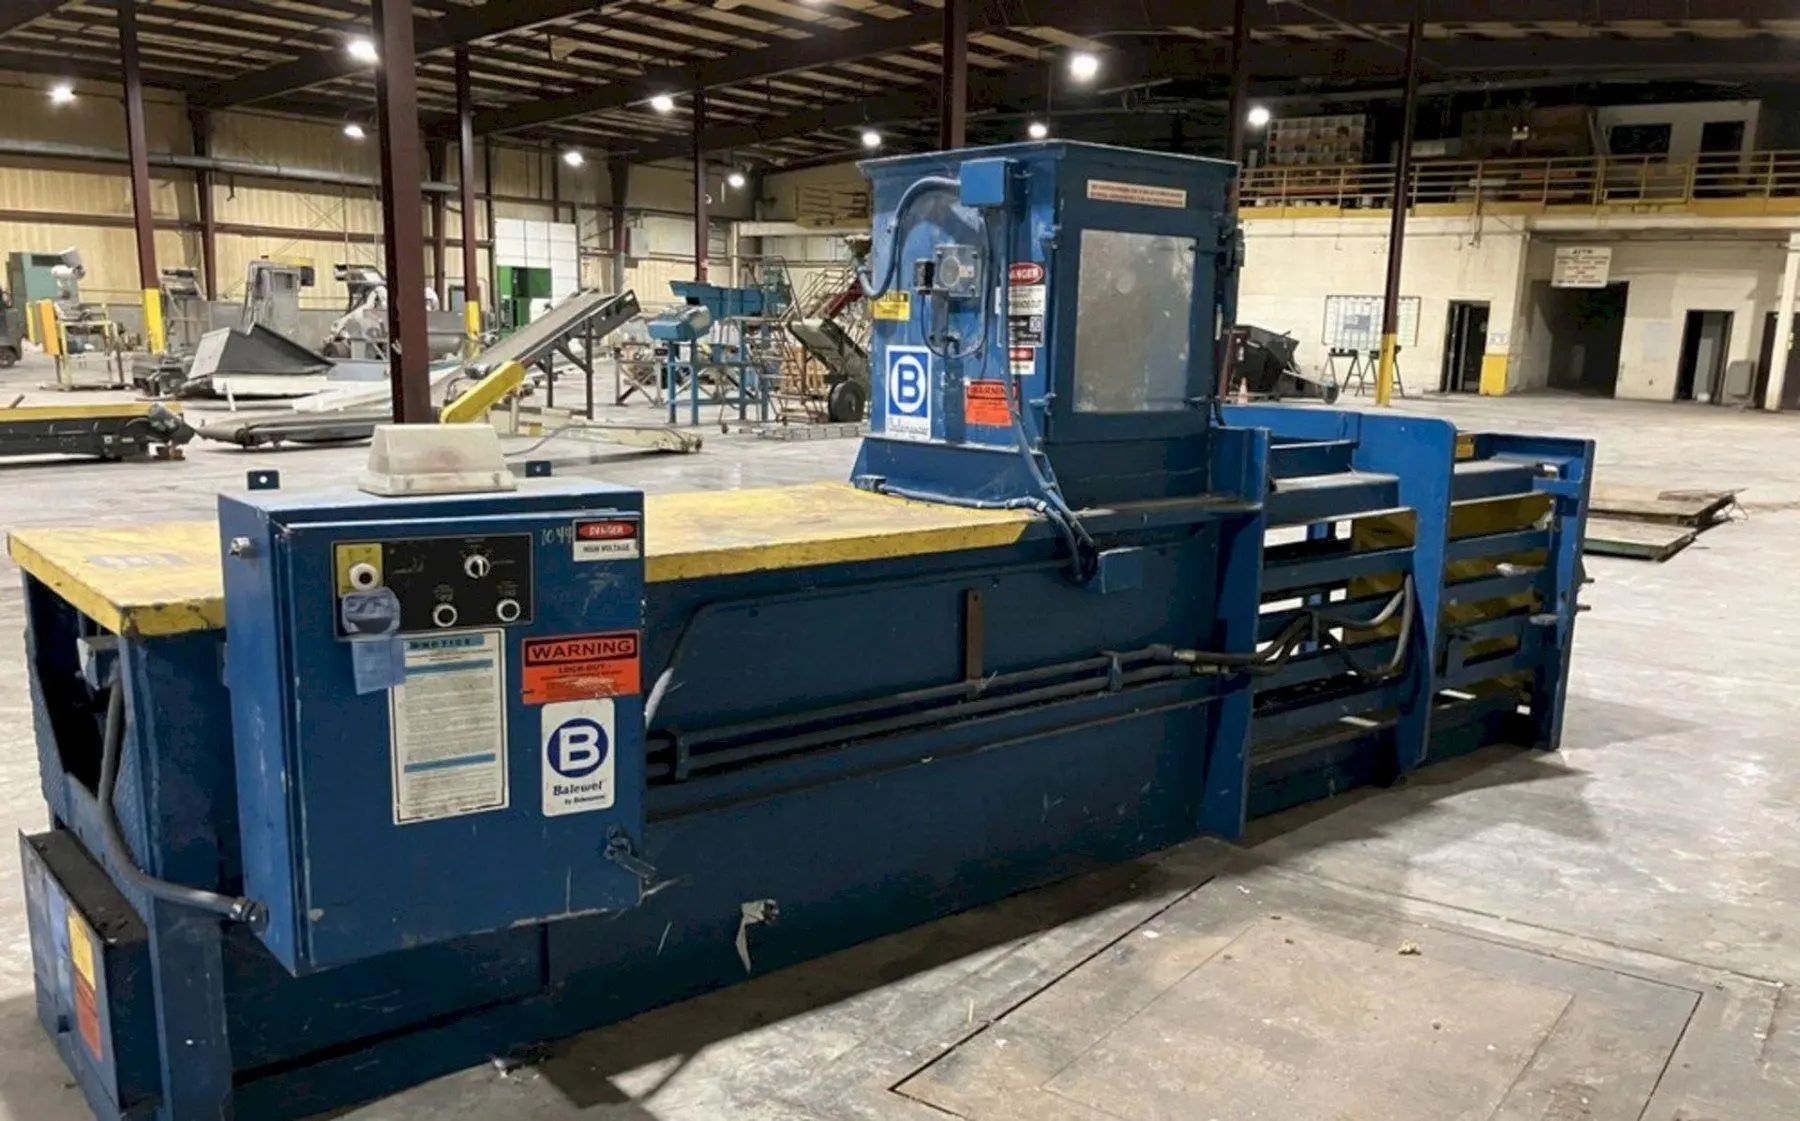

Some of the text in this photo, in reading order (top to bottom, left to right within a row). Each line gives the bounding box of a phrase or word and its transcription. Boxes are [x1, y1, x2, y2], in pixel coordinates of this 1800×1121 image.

[898, 363, 920, 404] B
[601, 543, 630, 552] VOLTAGE
[531, 639, 632, 659] WARNING
[559, 725, 600, 772] B
[553, 780, 603, 797] Balewel
